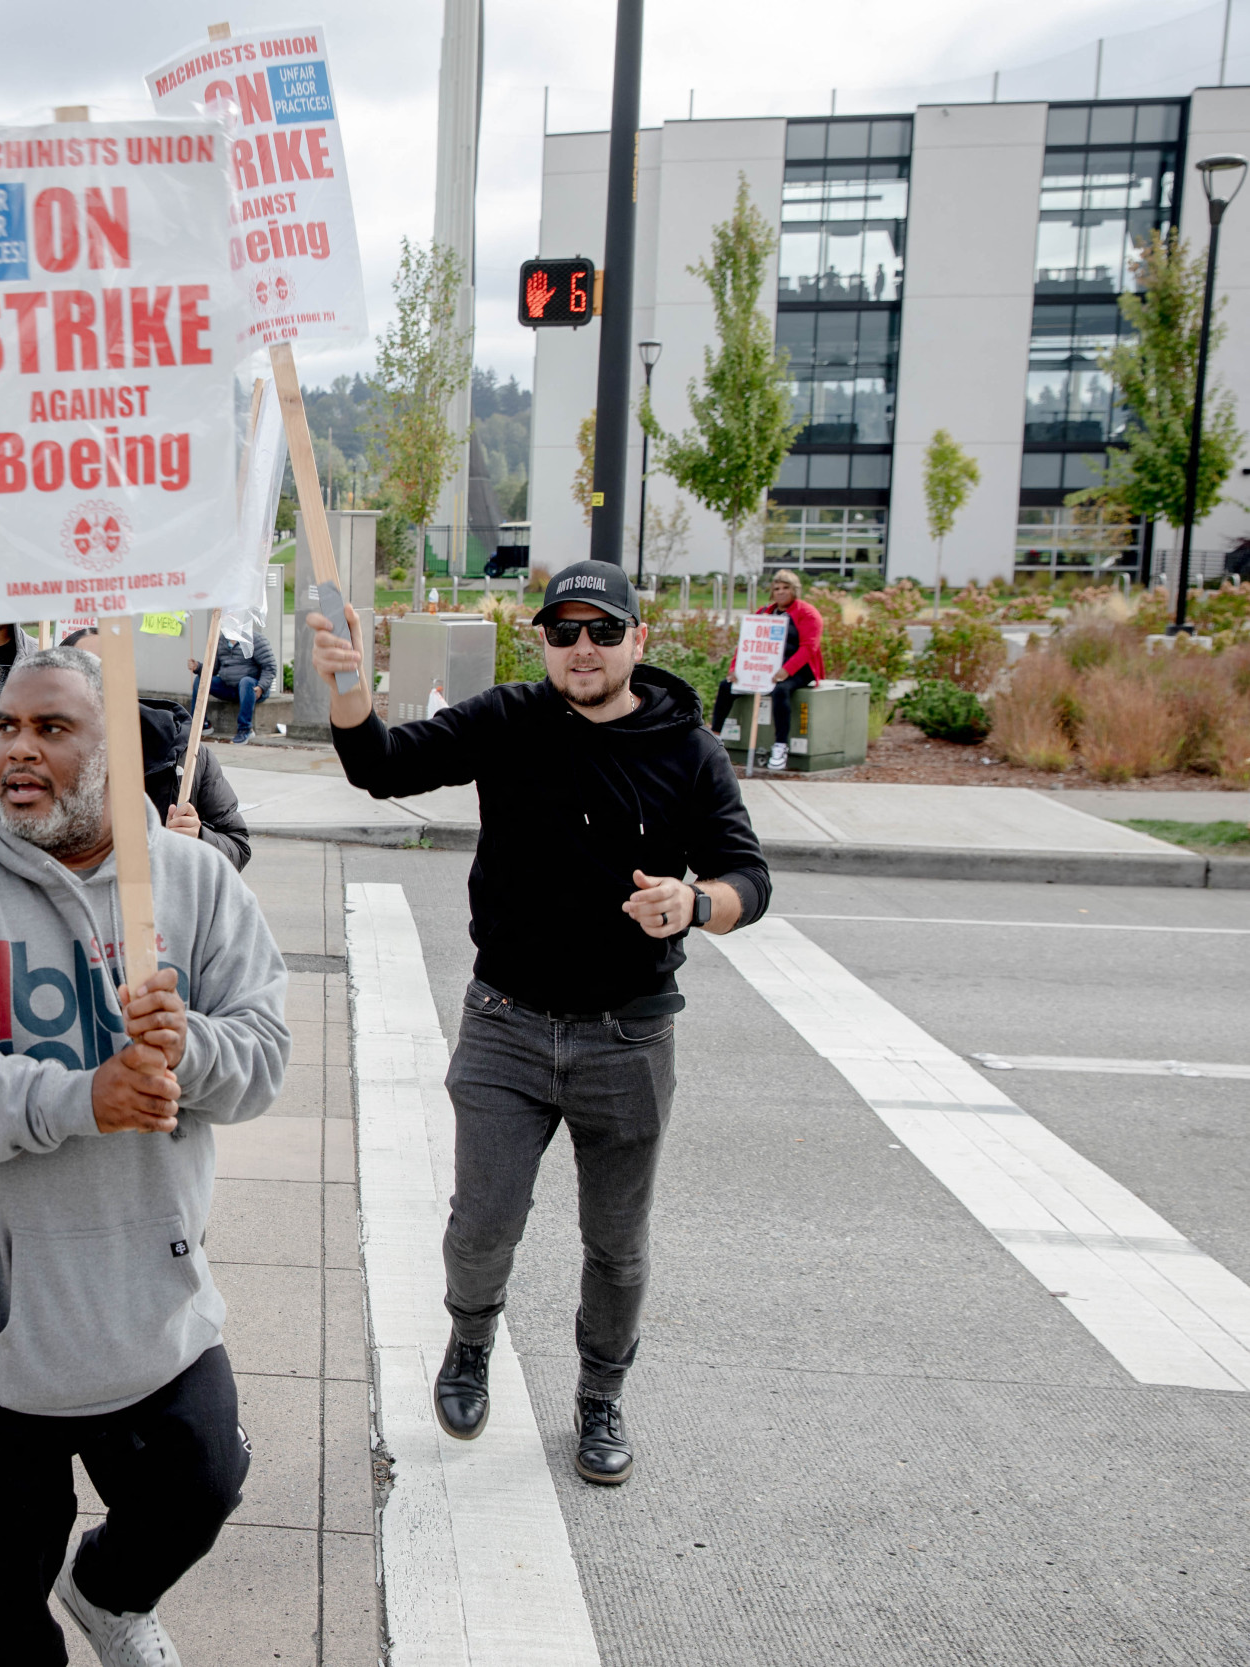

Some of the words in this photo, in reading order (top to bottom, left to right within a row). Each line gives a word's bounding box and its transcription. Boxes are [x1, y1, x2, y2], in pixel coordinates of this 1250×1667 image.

[155, 43, 256, 97] MACHINISTS
[259, 35, 318, 58] UNION
[279, 65, 316, 82] UNFAIR
[283, 80, 317, 98] LABOR
[204, 72, 273, 127] ON
[274, 96, 331, 116] PRACTICES!
[125, 134, 215, 166] UNION
[33, 186, 131, 274] ON
[570, 271, 587, 312] 6
[255, 314, 295, 334] DISTRICT
[295, 310, 322, 323] LODGE
[323, 310, 336, 322] 751
[262, 326, 299, 344] AFL-CIO
[29, 385, 151, 423] AGAINST
[6, 580, 63, 597] IAM&AW
[65, 576, 125, 595] DISTRICT
[128, 572, 164, 590] LODGE
[166, 571, 187, 586] 751
[555, 577, 574, 595] ANTI
[574, 575, 607, 592] SOCIAL
[74, 595, 127, 613] AFL-CIO
[144, 616, 154, 629] NO
[755, 625, 770, 639] ON
[742, 640, 780, 655] STRIKE
